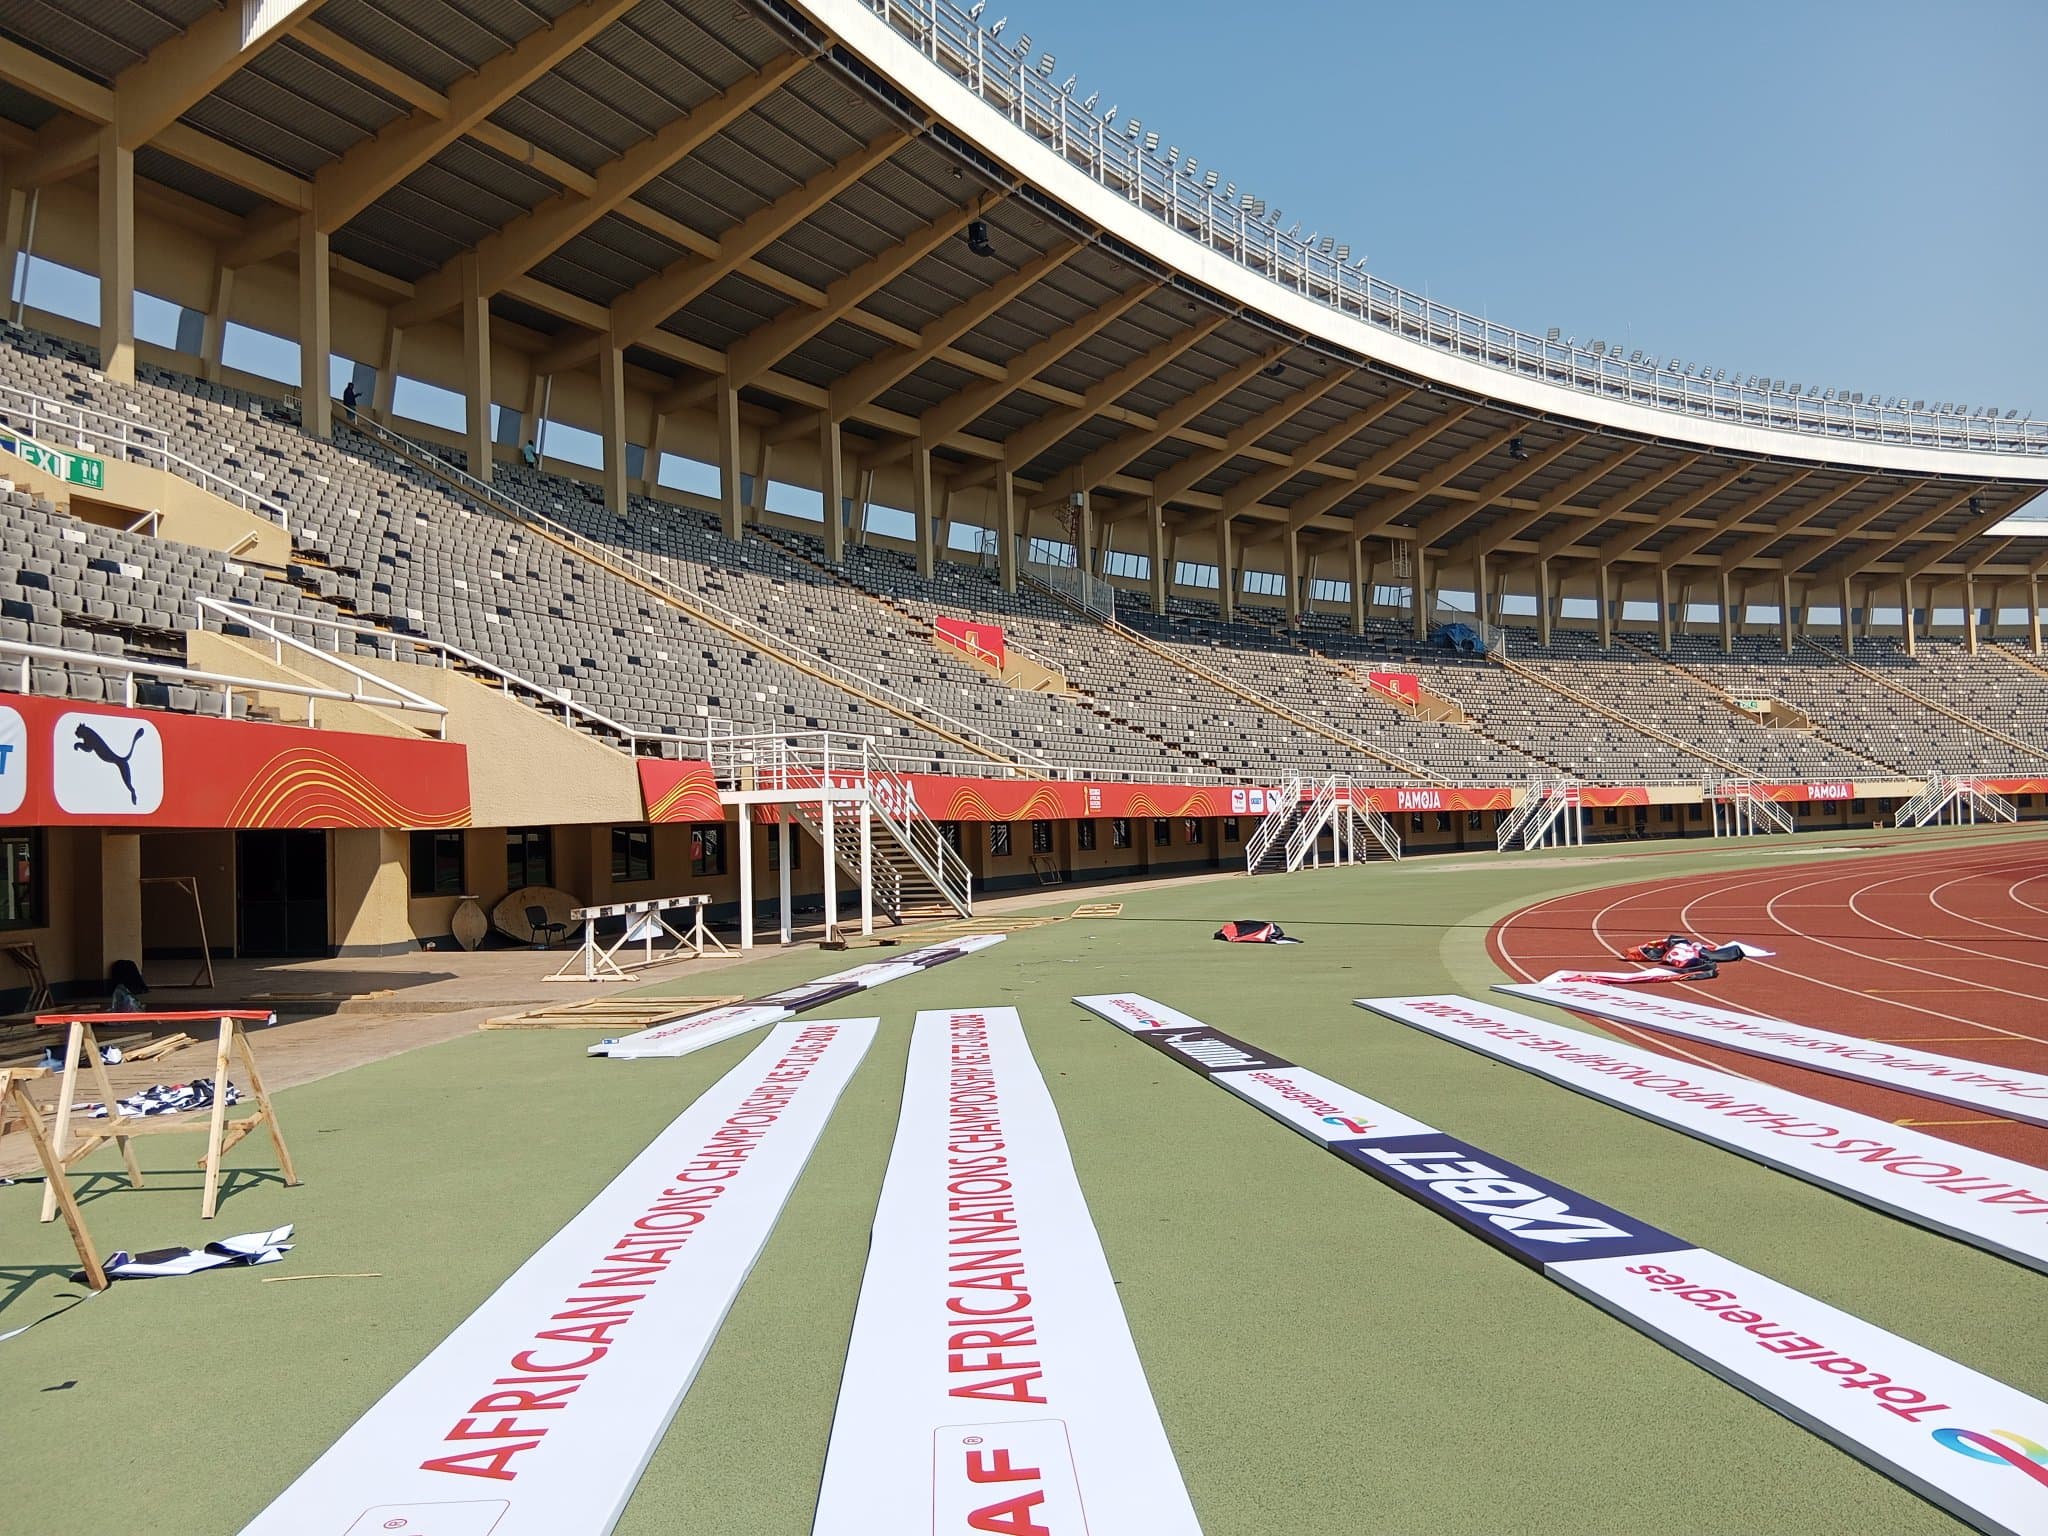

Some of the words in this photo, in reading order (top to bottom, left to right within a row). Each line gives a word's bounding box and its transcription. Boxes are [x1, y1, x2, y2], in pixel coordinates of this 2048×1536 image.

[1397, 791, 1441, 809] PAMOJA
[1807, 785, 1848, 799] PAMOJA
[947, 1068, 1005, 1153] CHAMPIONSHIP
[1248, 1072, 1344, 1116] TotalEnergies
[1554, 1053, 1839, 1137] CHAMPIONSHIP
[947, 1156, 1020, 1244] NATIONS
[1359, 1148, 1633, 1243] 1XBET
[1811, 1139, 2048, 1224] ATIONS
[418, 1293, 646, 1481] AFRICAN
[578, 1185, 725, 1288] NATIONS
[676, 1085, 798, 1182] CHAMPIONSHIP
[946, 1249, 1048, 1404] AFRICAN
[1625, 1264, 1951, 1423] TotalEnergies
